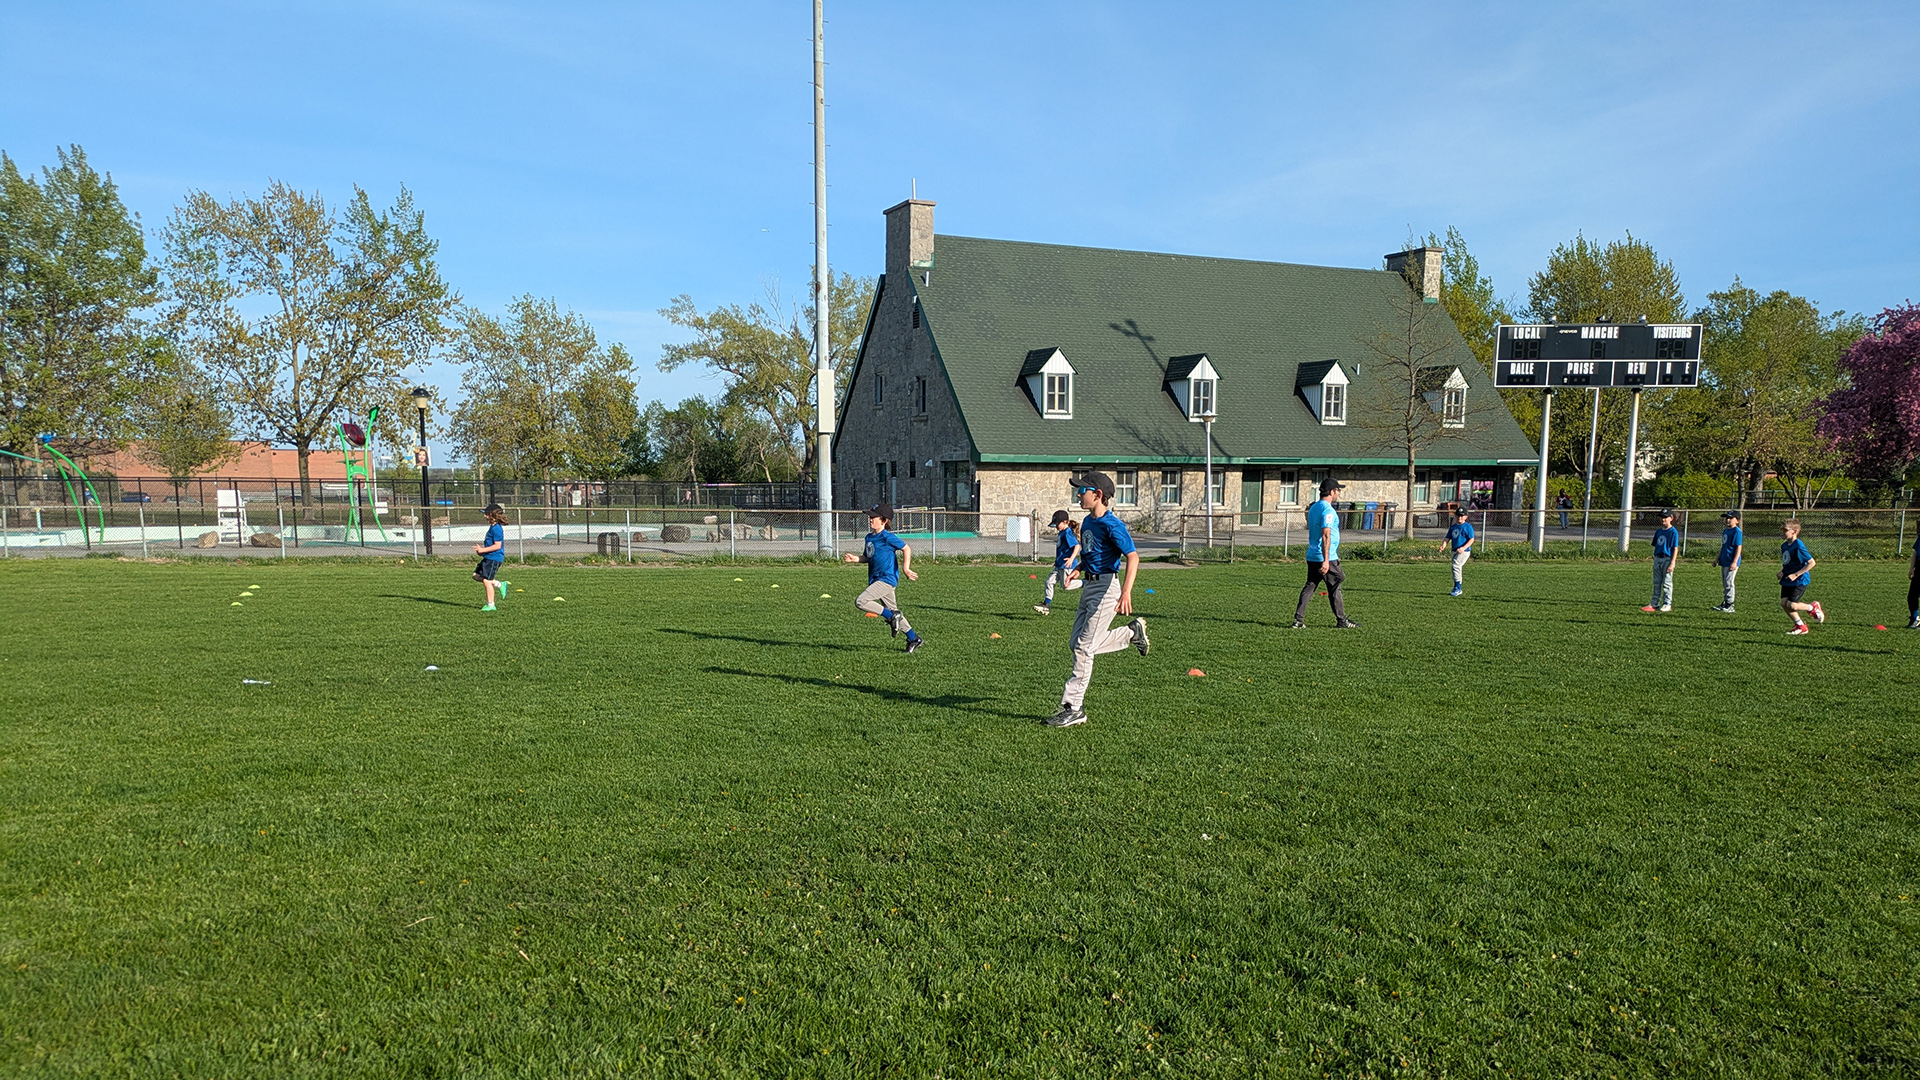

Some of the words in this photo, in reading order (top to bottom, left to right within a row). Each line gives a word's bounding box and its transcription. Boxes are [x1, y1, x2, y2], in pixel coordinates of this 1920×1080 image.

[1513, 327, 1541, 339] LOCAL
[1581, 326, 1620, 339] MANCHE
[1653, 326, 1693, 339] VISITEURS
[1510, 362, 1535, 375] BALLE
[1566, 362, 1595, 375] PRISE
[1684, 362, 1691, 375] E
